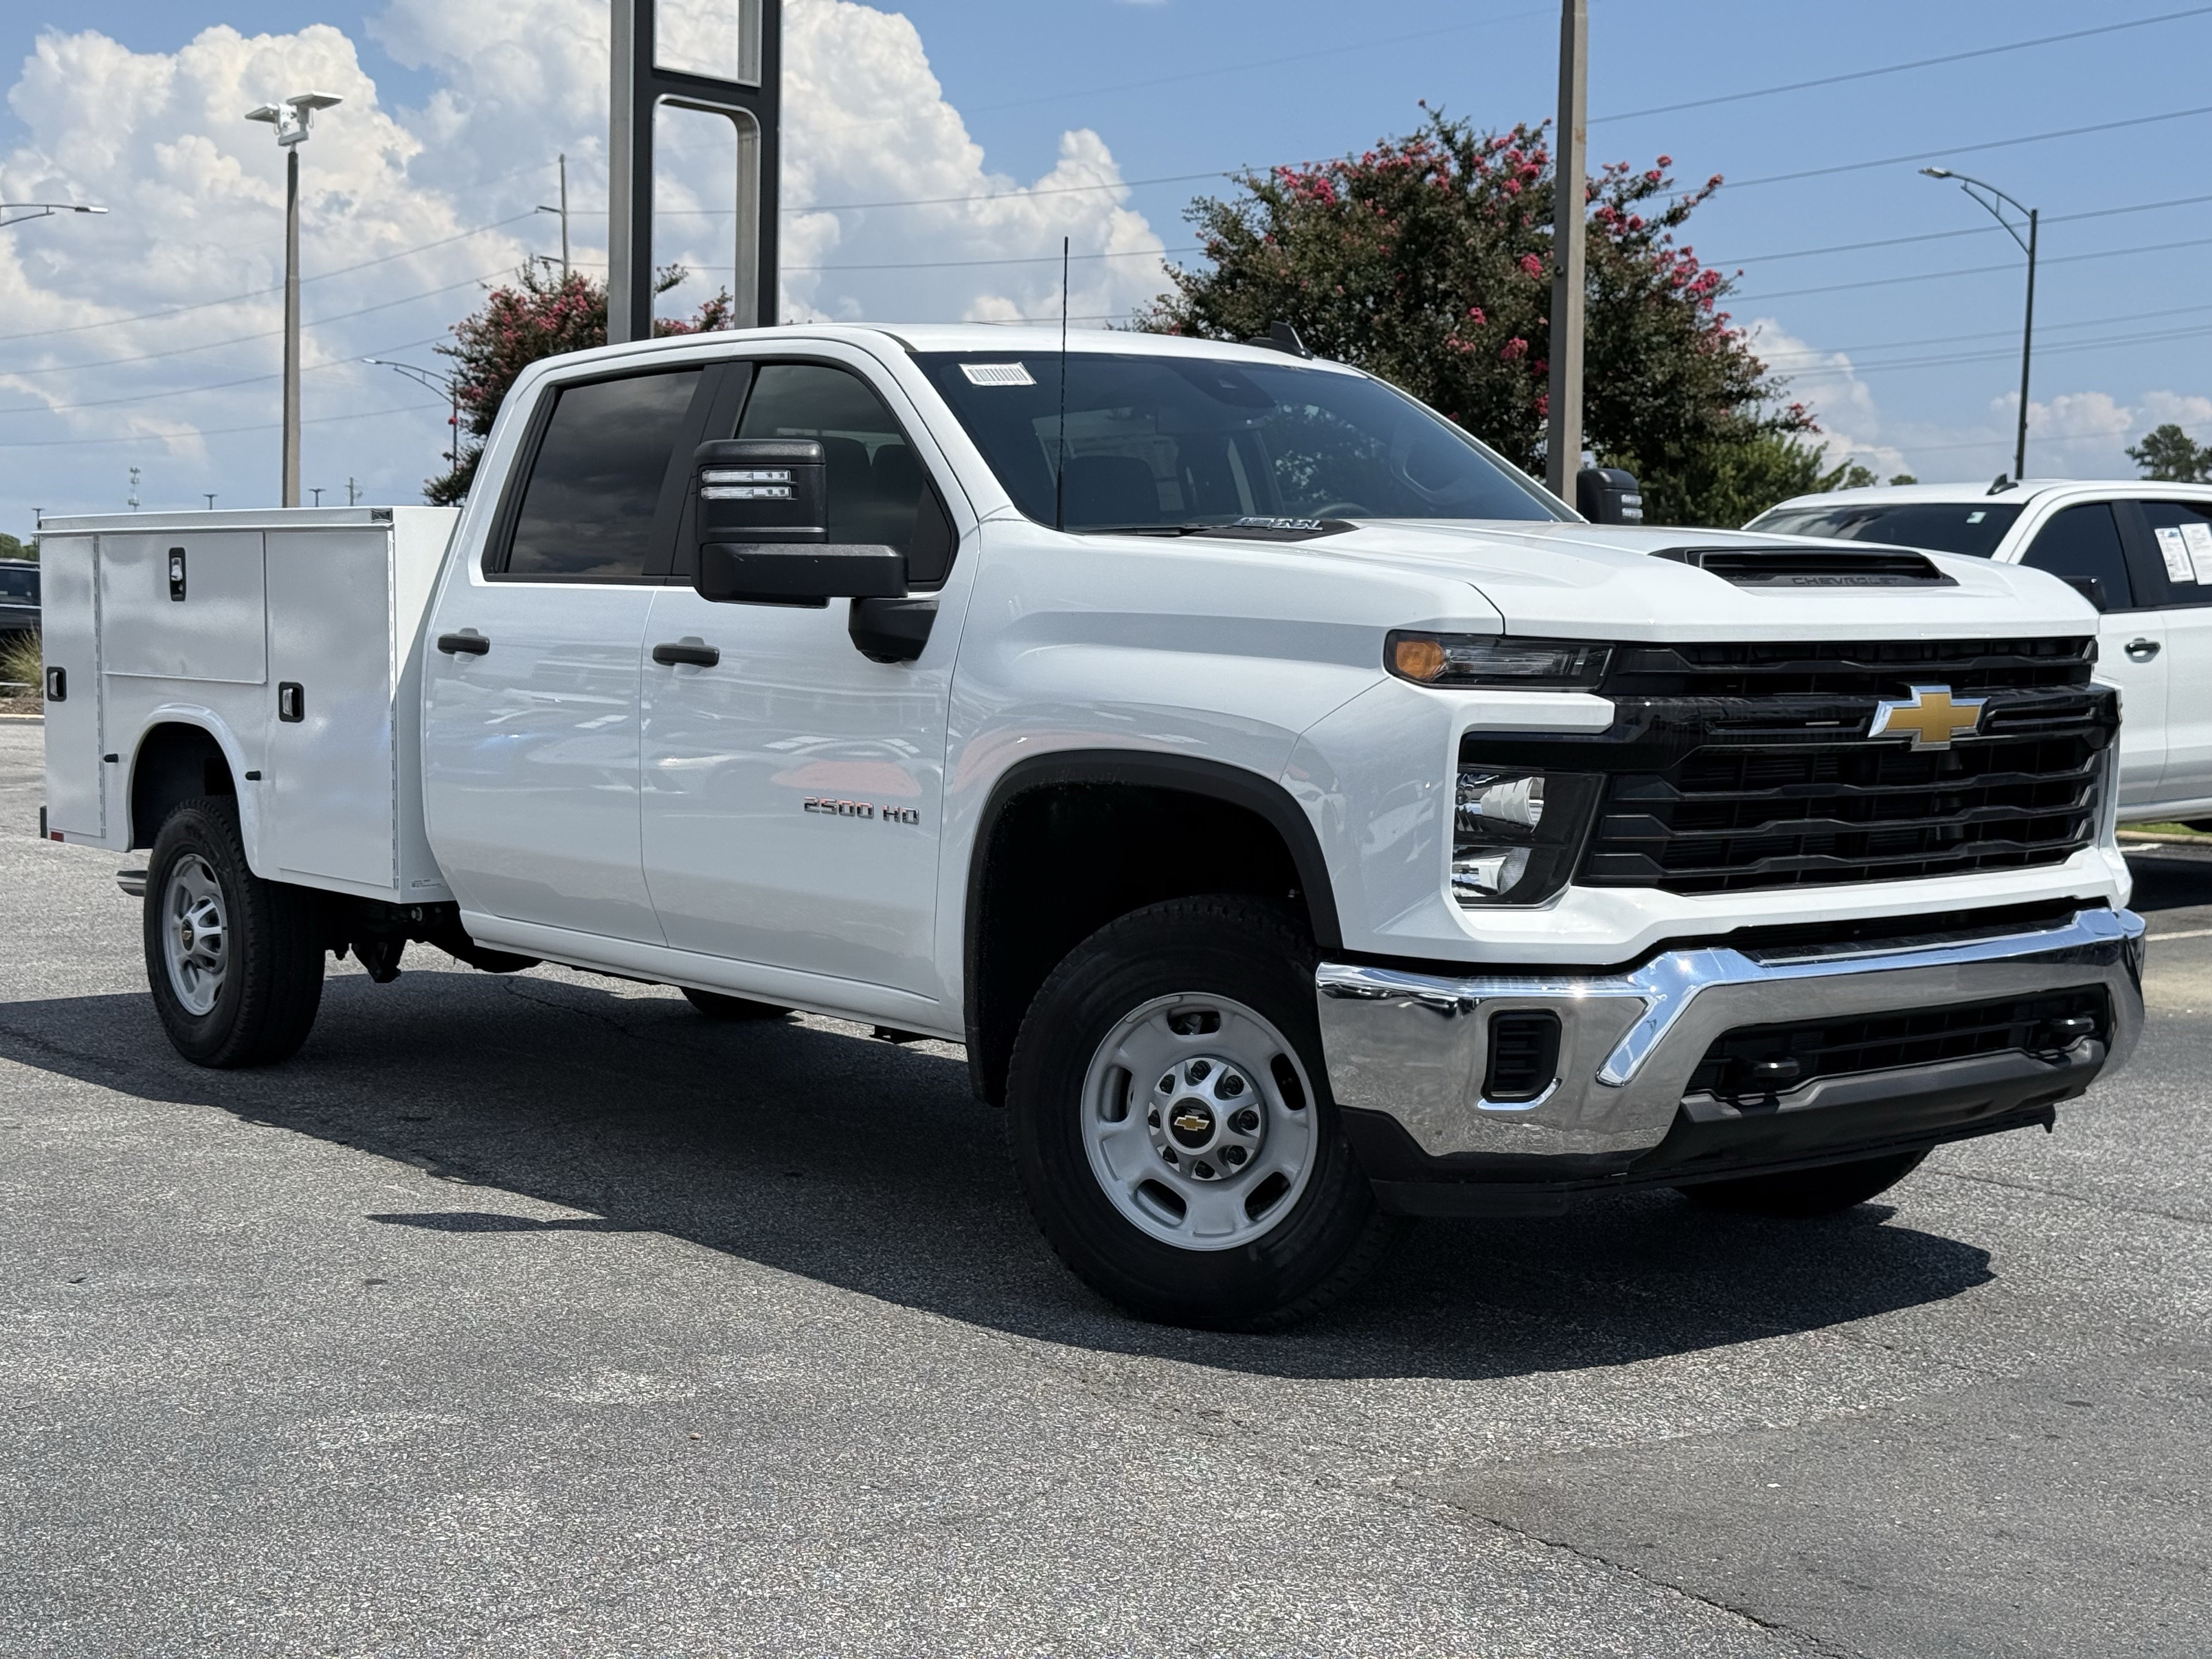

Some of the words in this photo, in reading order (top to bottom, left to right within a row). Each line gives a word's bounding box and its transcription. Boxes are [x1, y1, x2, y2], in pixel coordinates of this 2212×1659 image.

[1791, 577, 1899, 585] CHEVROLET
[804, 795, 875, 819] 2500
[882, 804, 920, 825] HD
